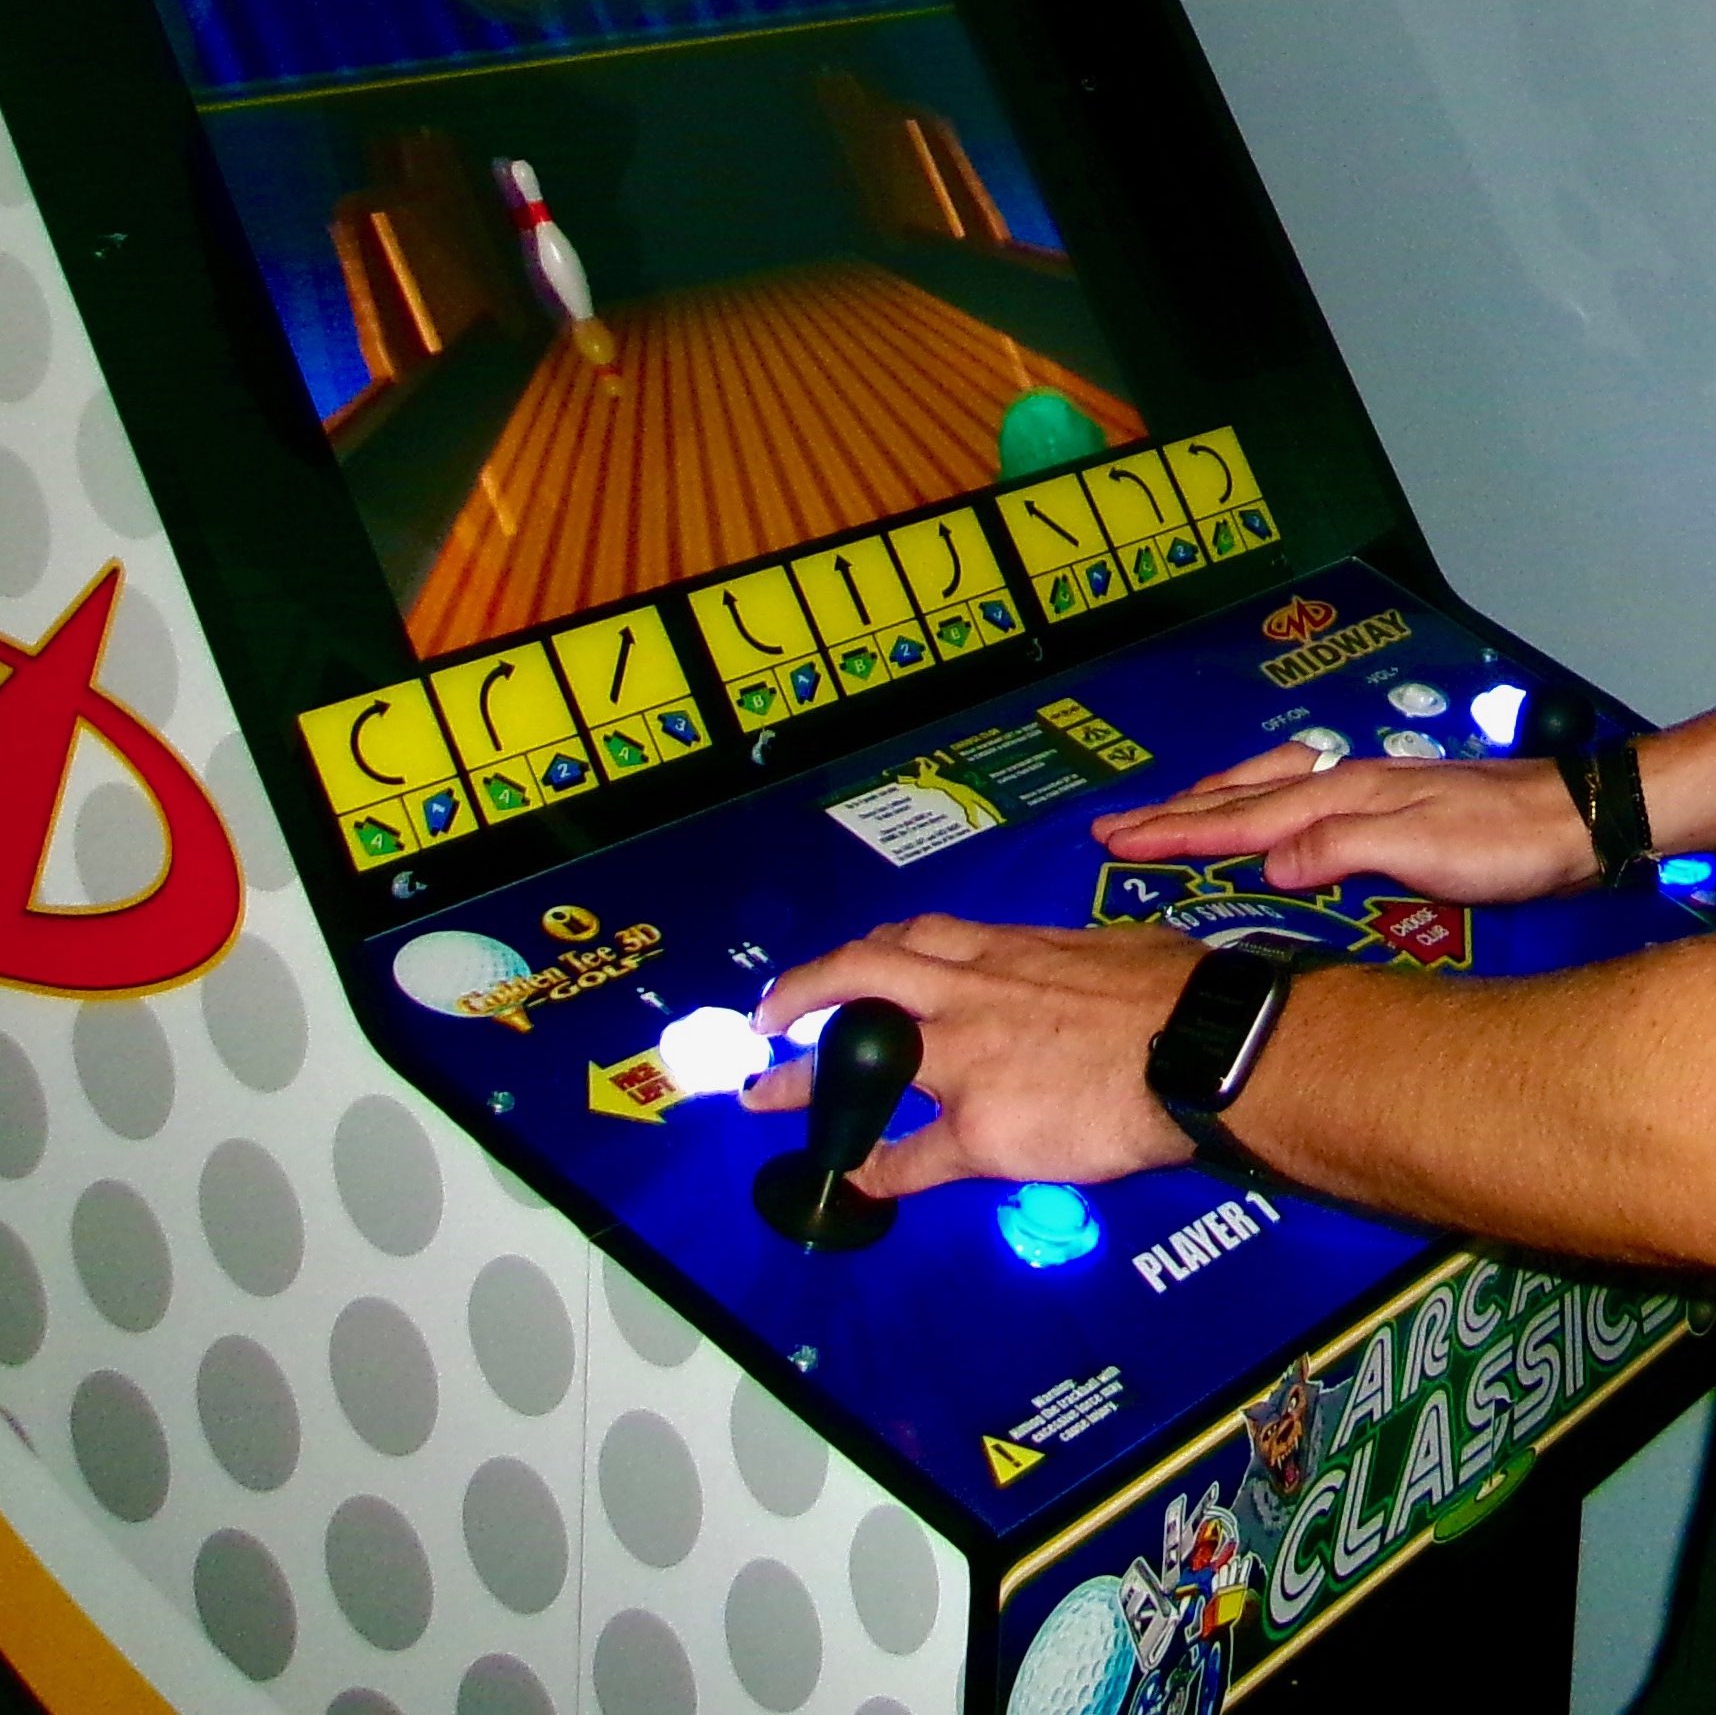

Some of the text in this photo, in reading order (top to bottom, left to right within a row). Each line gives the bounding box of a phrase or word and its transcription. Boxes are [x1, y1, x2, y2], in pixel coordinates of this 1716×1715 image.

[1263, 610, 1410, 687] MIDWAY
[1123, 877, 1160, 903] 2
[1194, 901, 1286, 922] SWING
[1389, 906, 1438, 937] CHOOSE
[456, 923, 662, 1014] Golden Tee 3D
[1131, 1190, 1281, 1294] PLAYER 1
